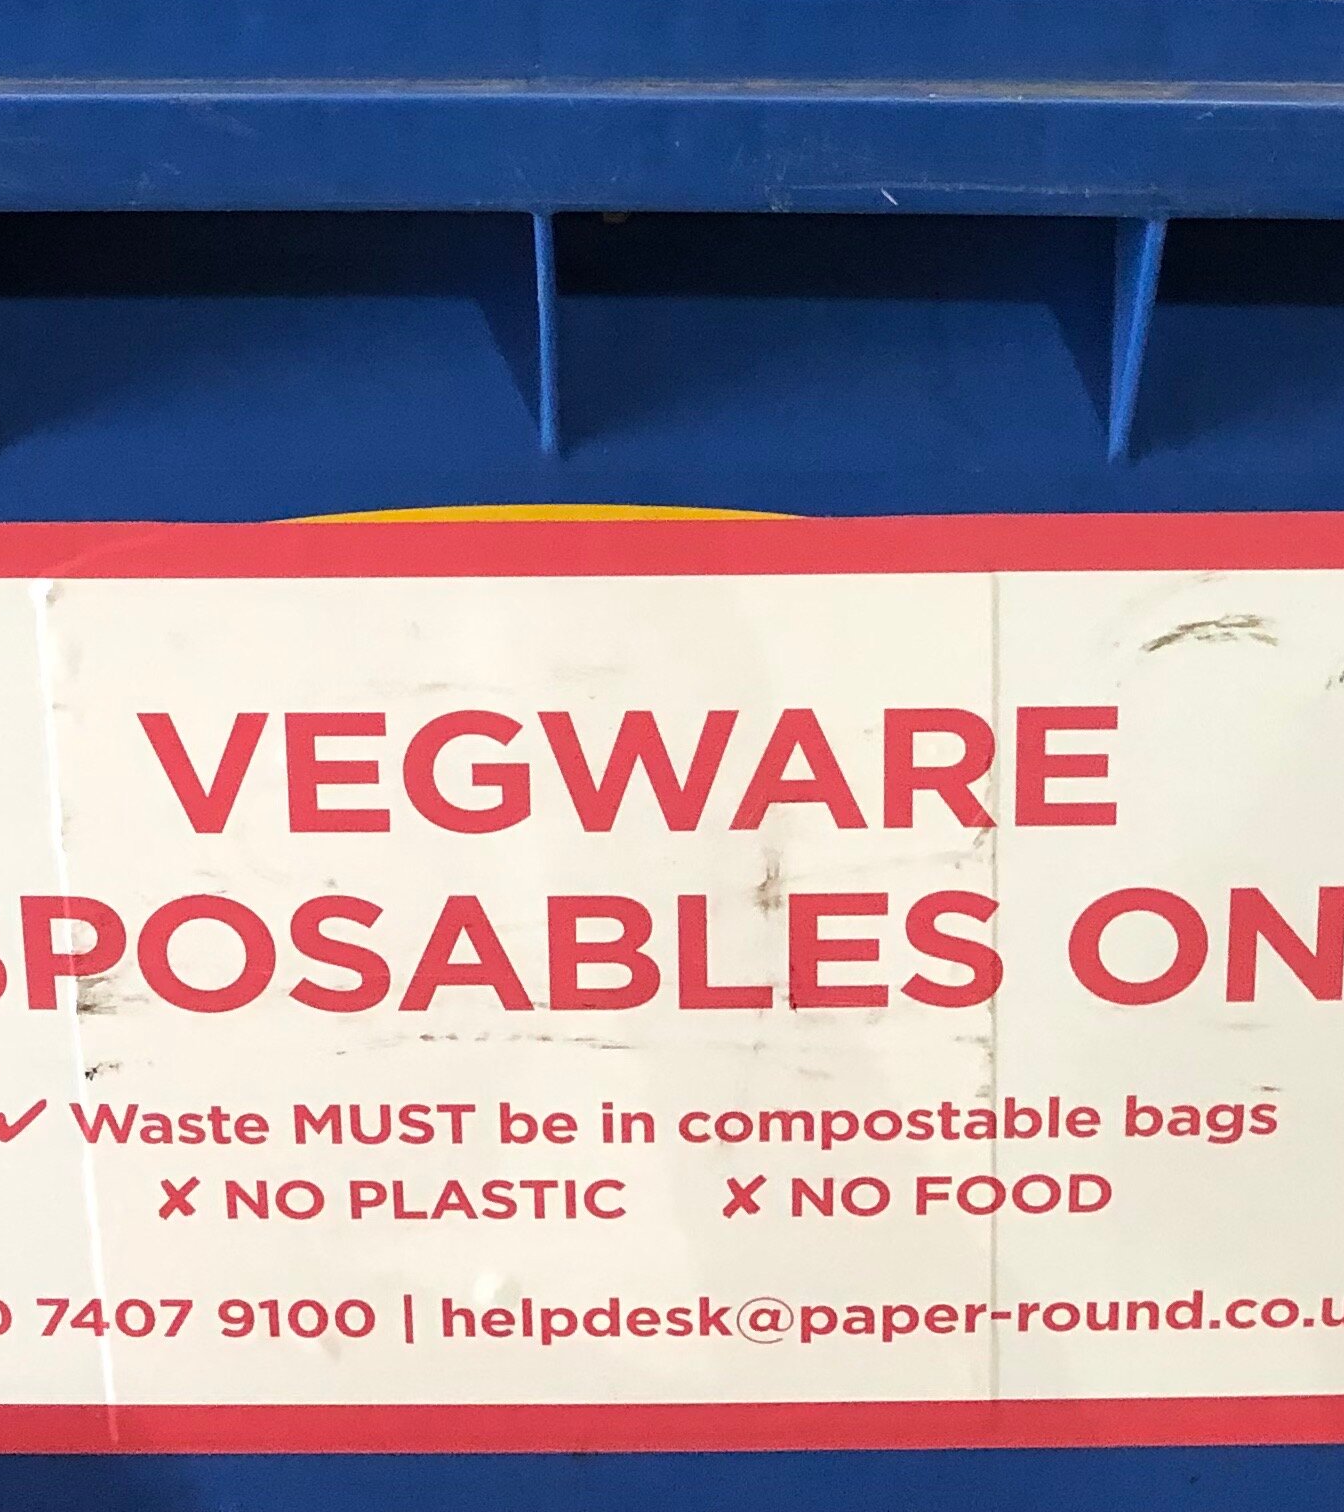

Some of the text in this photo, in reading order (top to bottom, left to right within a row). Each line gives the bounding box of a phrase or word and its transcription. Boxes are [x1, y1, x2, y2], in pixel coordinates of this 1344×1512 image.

[137, 706, 1118, 834] VEGWARE
[75, 1095, 1278, 1151] Waste MUST be in compostable bags
[225, 1179, 625, 1220] NO PLASTIC
[791, 1173, 1112, 1217] NO FOOD
[36, 1298, 193, 1338] 7407
[218, 1299, 376, 1338] 9100
